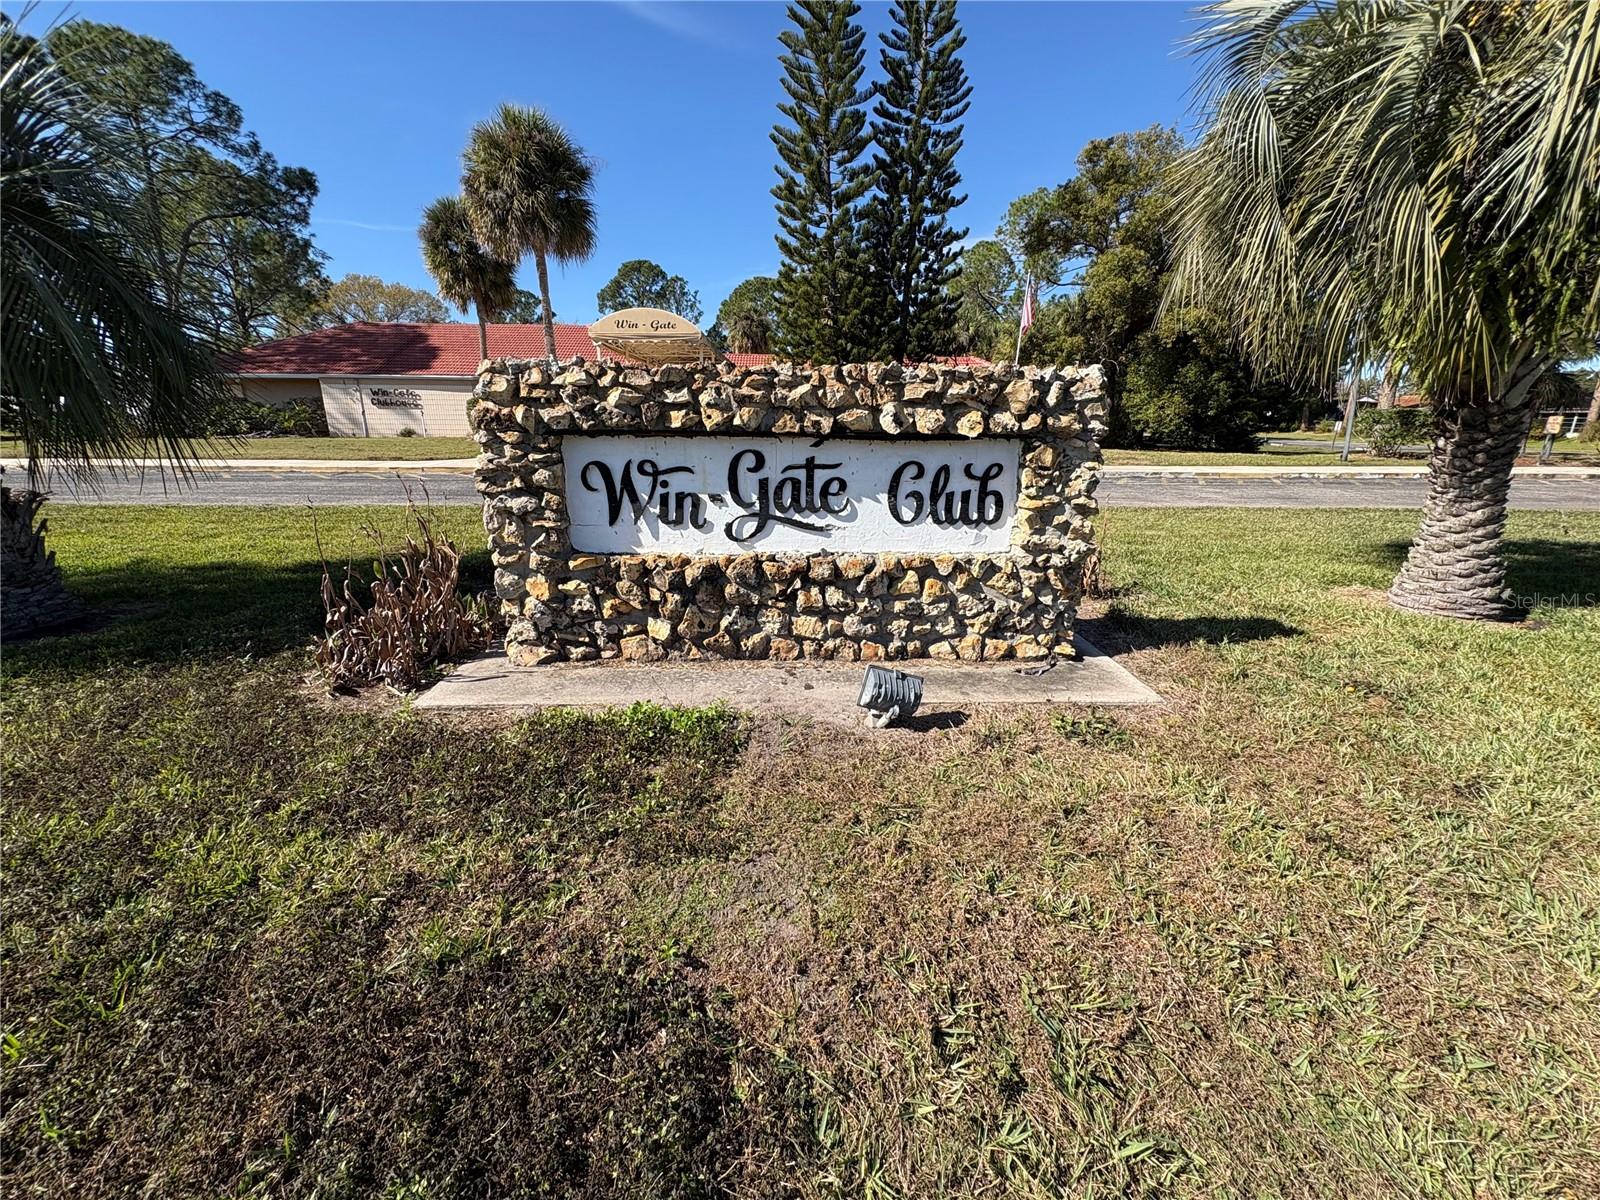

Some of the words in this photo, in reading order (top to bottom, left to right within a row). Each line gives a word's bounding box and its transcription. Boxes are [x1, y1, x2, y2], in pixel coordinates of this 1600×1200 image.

[613, 319, 639, 329] Win
[650, 320, 677, 332] Gate
[580, 449, 850, 543] Win-Gate
[886, 460, 1005, 527] Club
